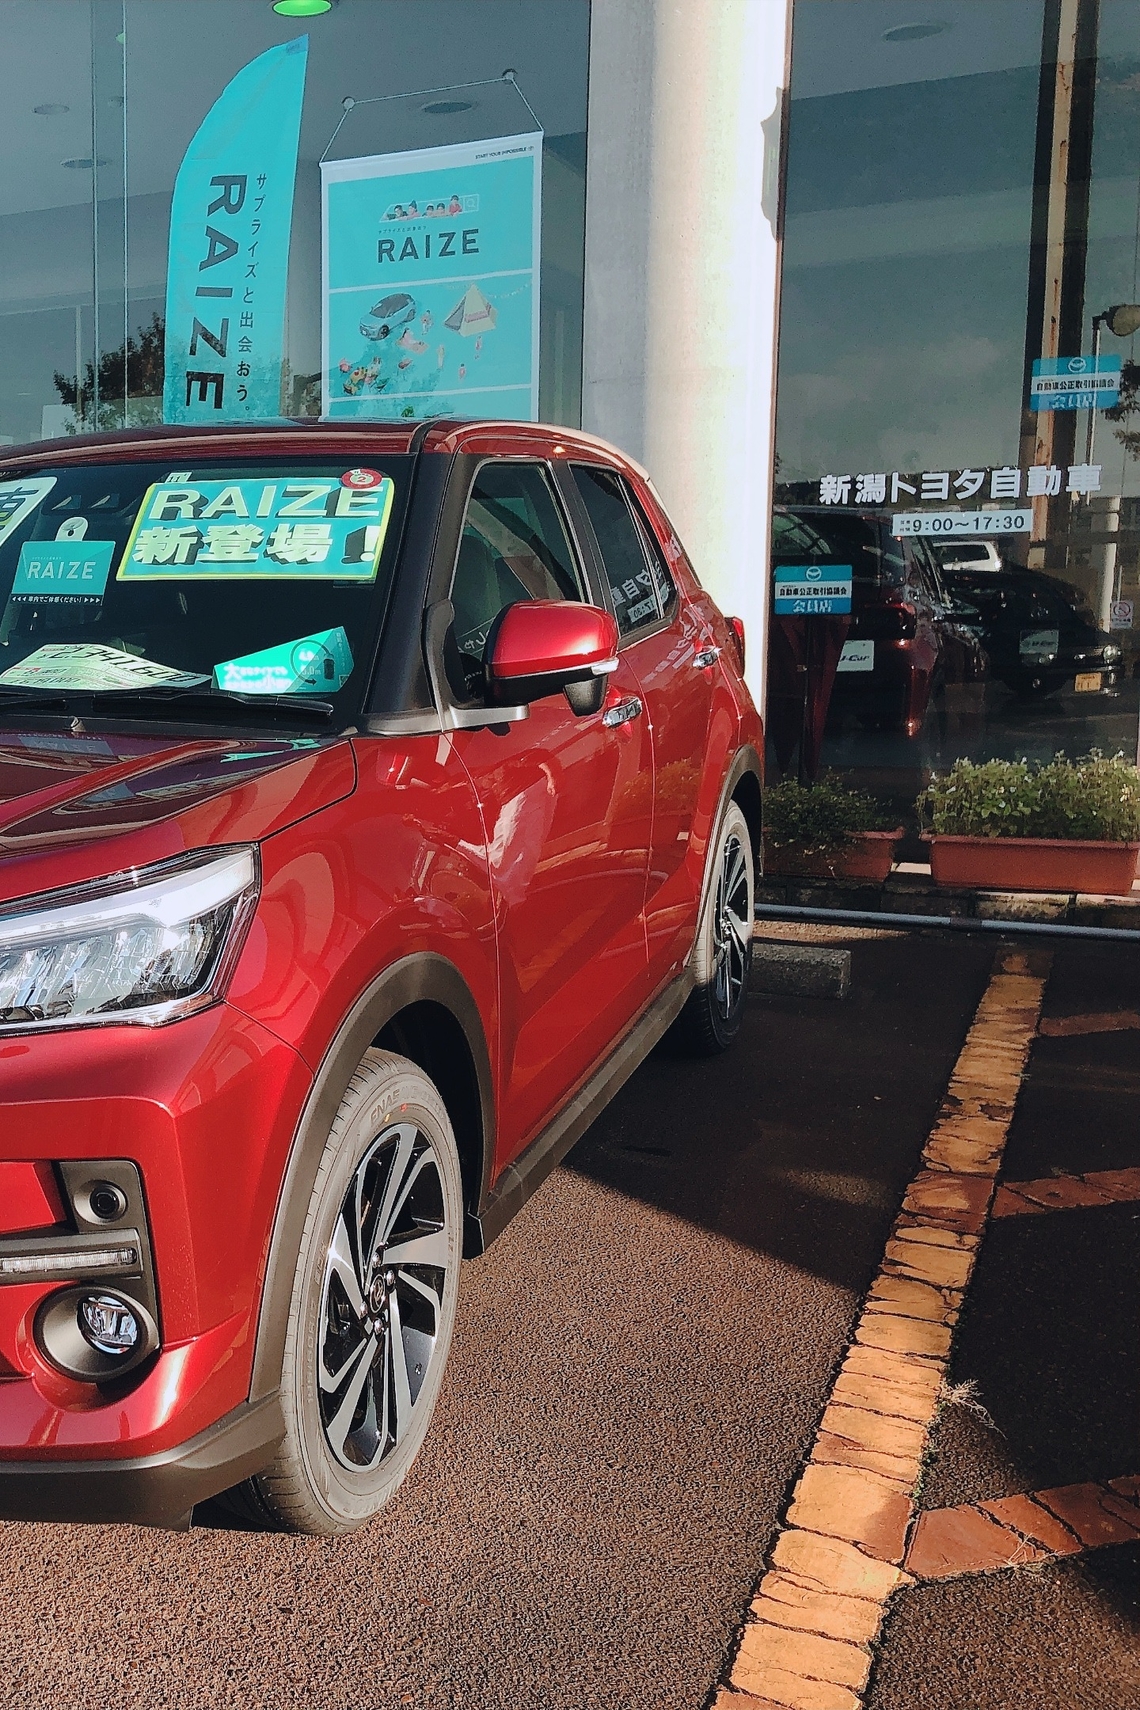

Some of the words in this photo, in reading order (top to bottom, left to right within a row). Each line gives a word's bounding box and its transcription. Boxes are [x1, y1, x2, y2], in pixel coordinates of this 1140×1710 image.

[377, 228, 480, 264] RAIZE
[185, 174, 248, 409] RAIZE
[147, 484, 384, 518] RAIZE
[818, 464, 1103, 505] 新潟トヨタ自動車
[27, 561, 97, 580] RAIZE
